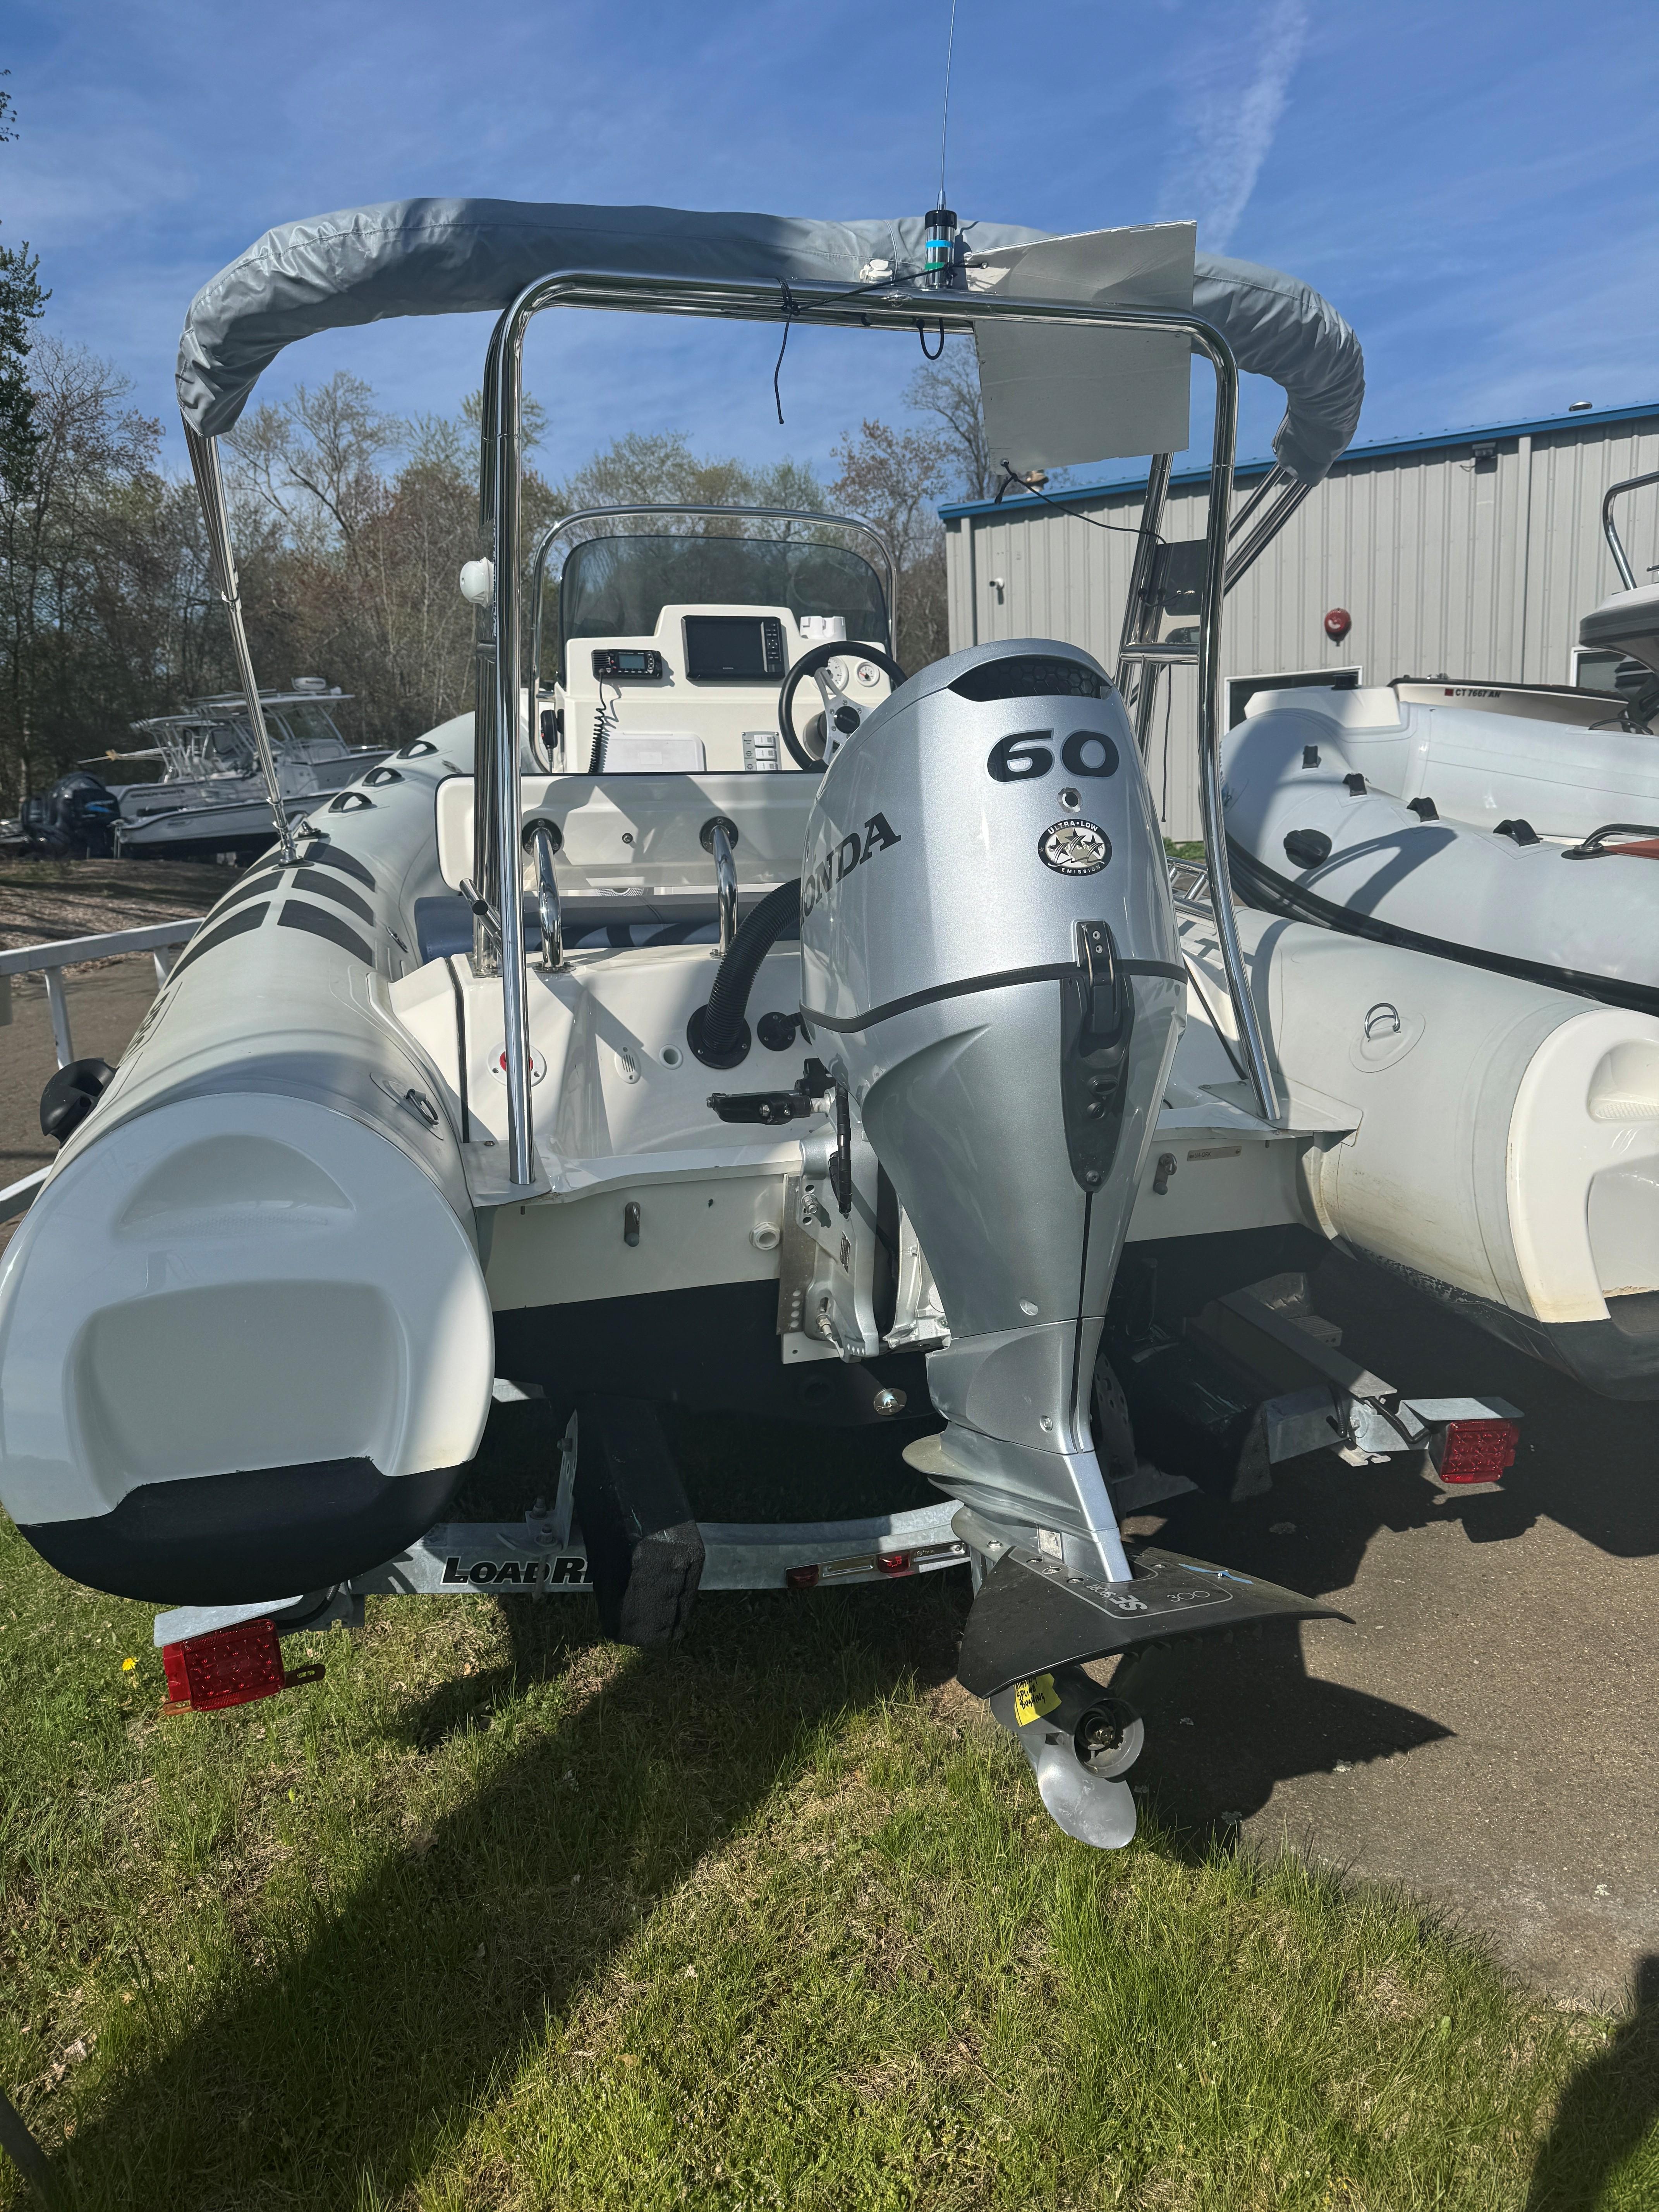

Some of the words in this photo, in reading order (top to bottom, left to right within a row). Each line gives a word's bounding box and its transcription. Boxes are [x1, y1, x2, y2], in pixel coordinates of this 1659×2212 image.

[1468, 689, 1487, 697] 7667
[987, 728, 1120, 784] 60
[802, 812, 902, 926] ONDA
[1061, 865, 1101, 874] EMISSION
[1085, 1583, 1117, 1598] SPORT
[1167, 1590, 1211, 1602] 300
[1108, 1595, 1148, 1611] SE
[1017, 1683, 1036, 1701] SPLINE
[1020, 1692, 1046, 1710] BUSHING
